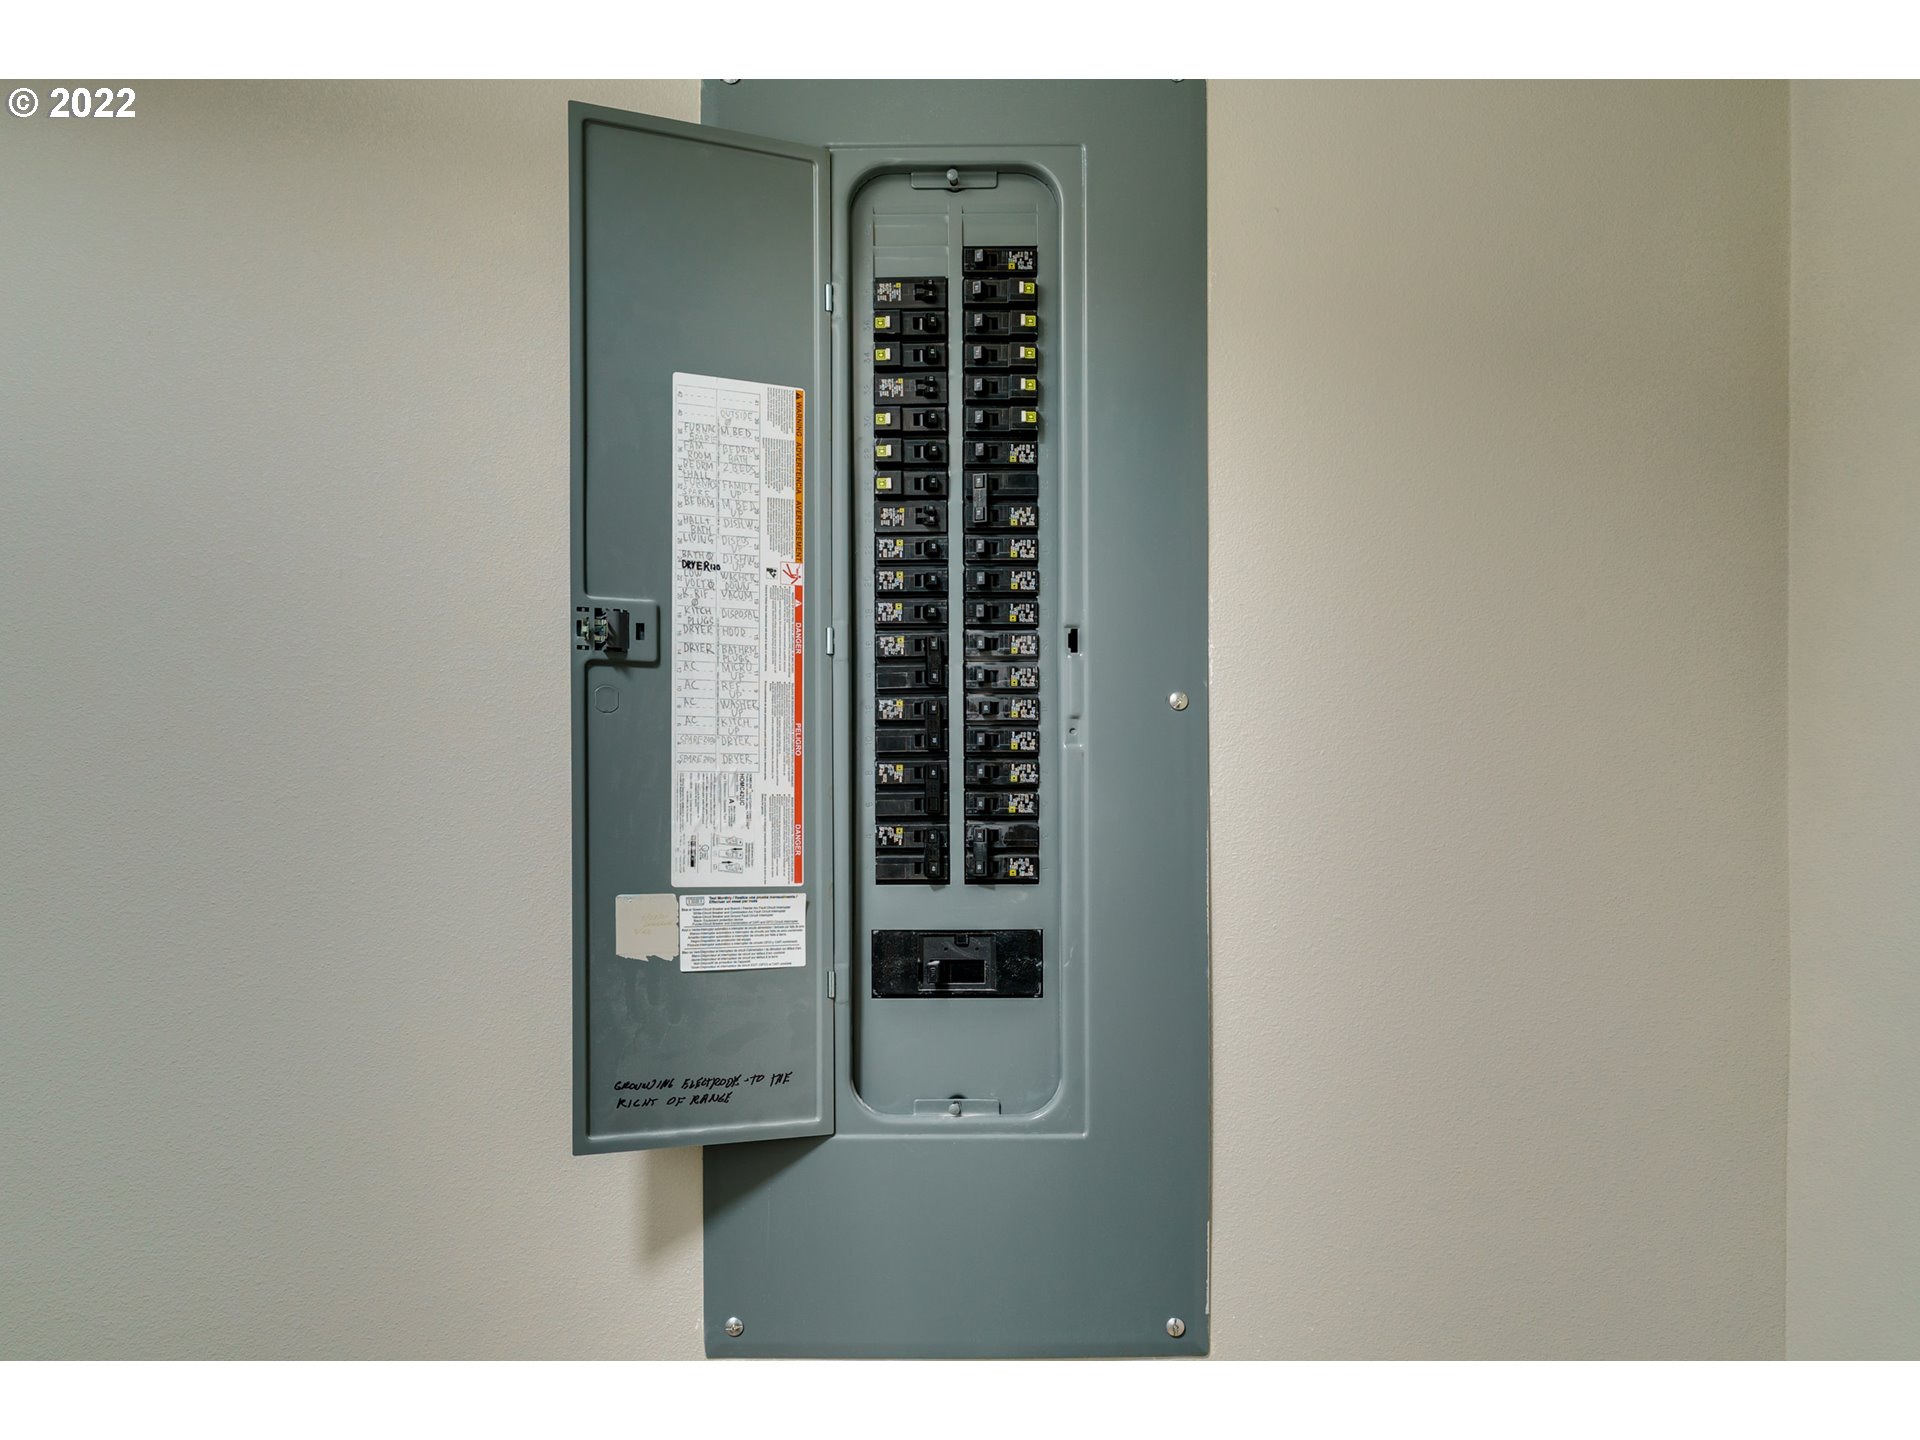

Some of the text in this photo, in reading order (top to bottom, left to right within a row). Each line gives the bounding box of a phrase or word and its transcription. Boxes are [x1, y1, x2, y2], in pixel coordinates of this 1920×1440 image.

[683, 624, 713, 634] DRYER
[683, 642, 715, 654] DRYER
[770, 1071, 793, 1087] THE
[666, 1096, 686, 1107] OF
[689, 1092, 733, 1105] RANGE
